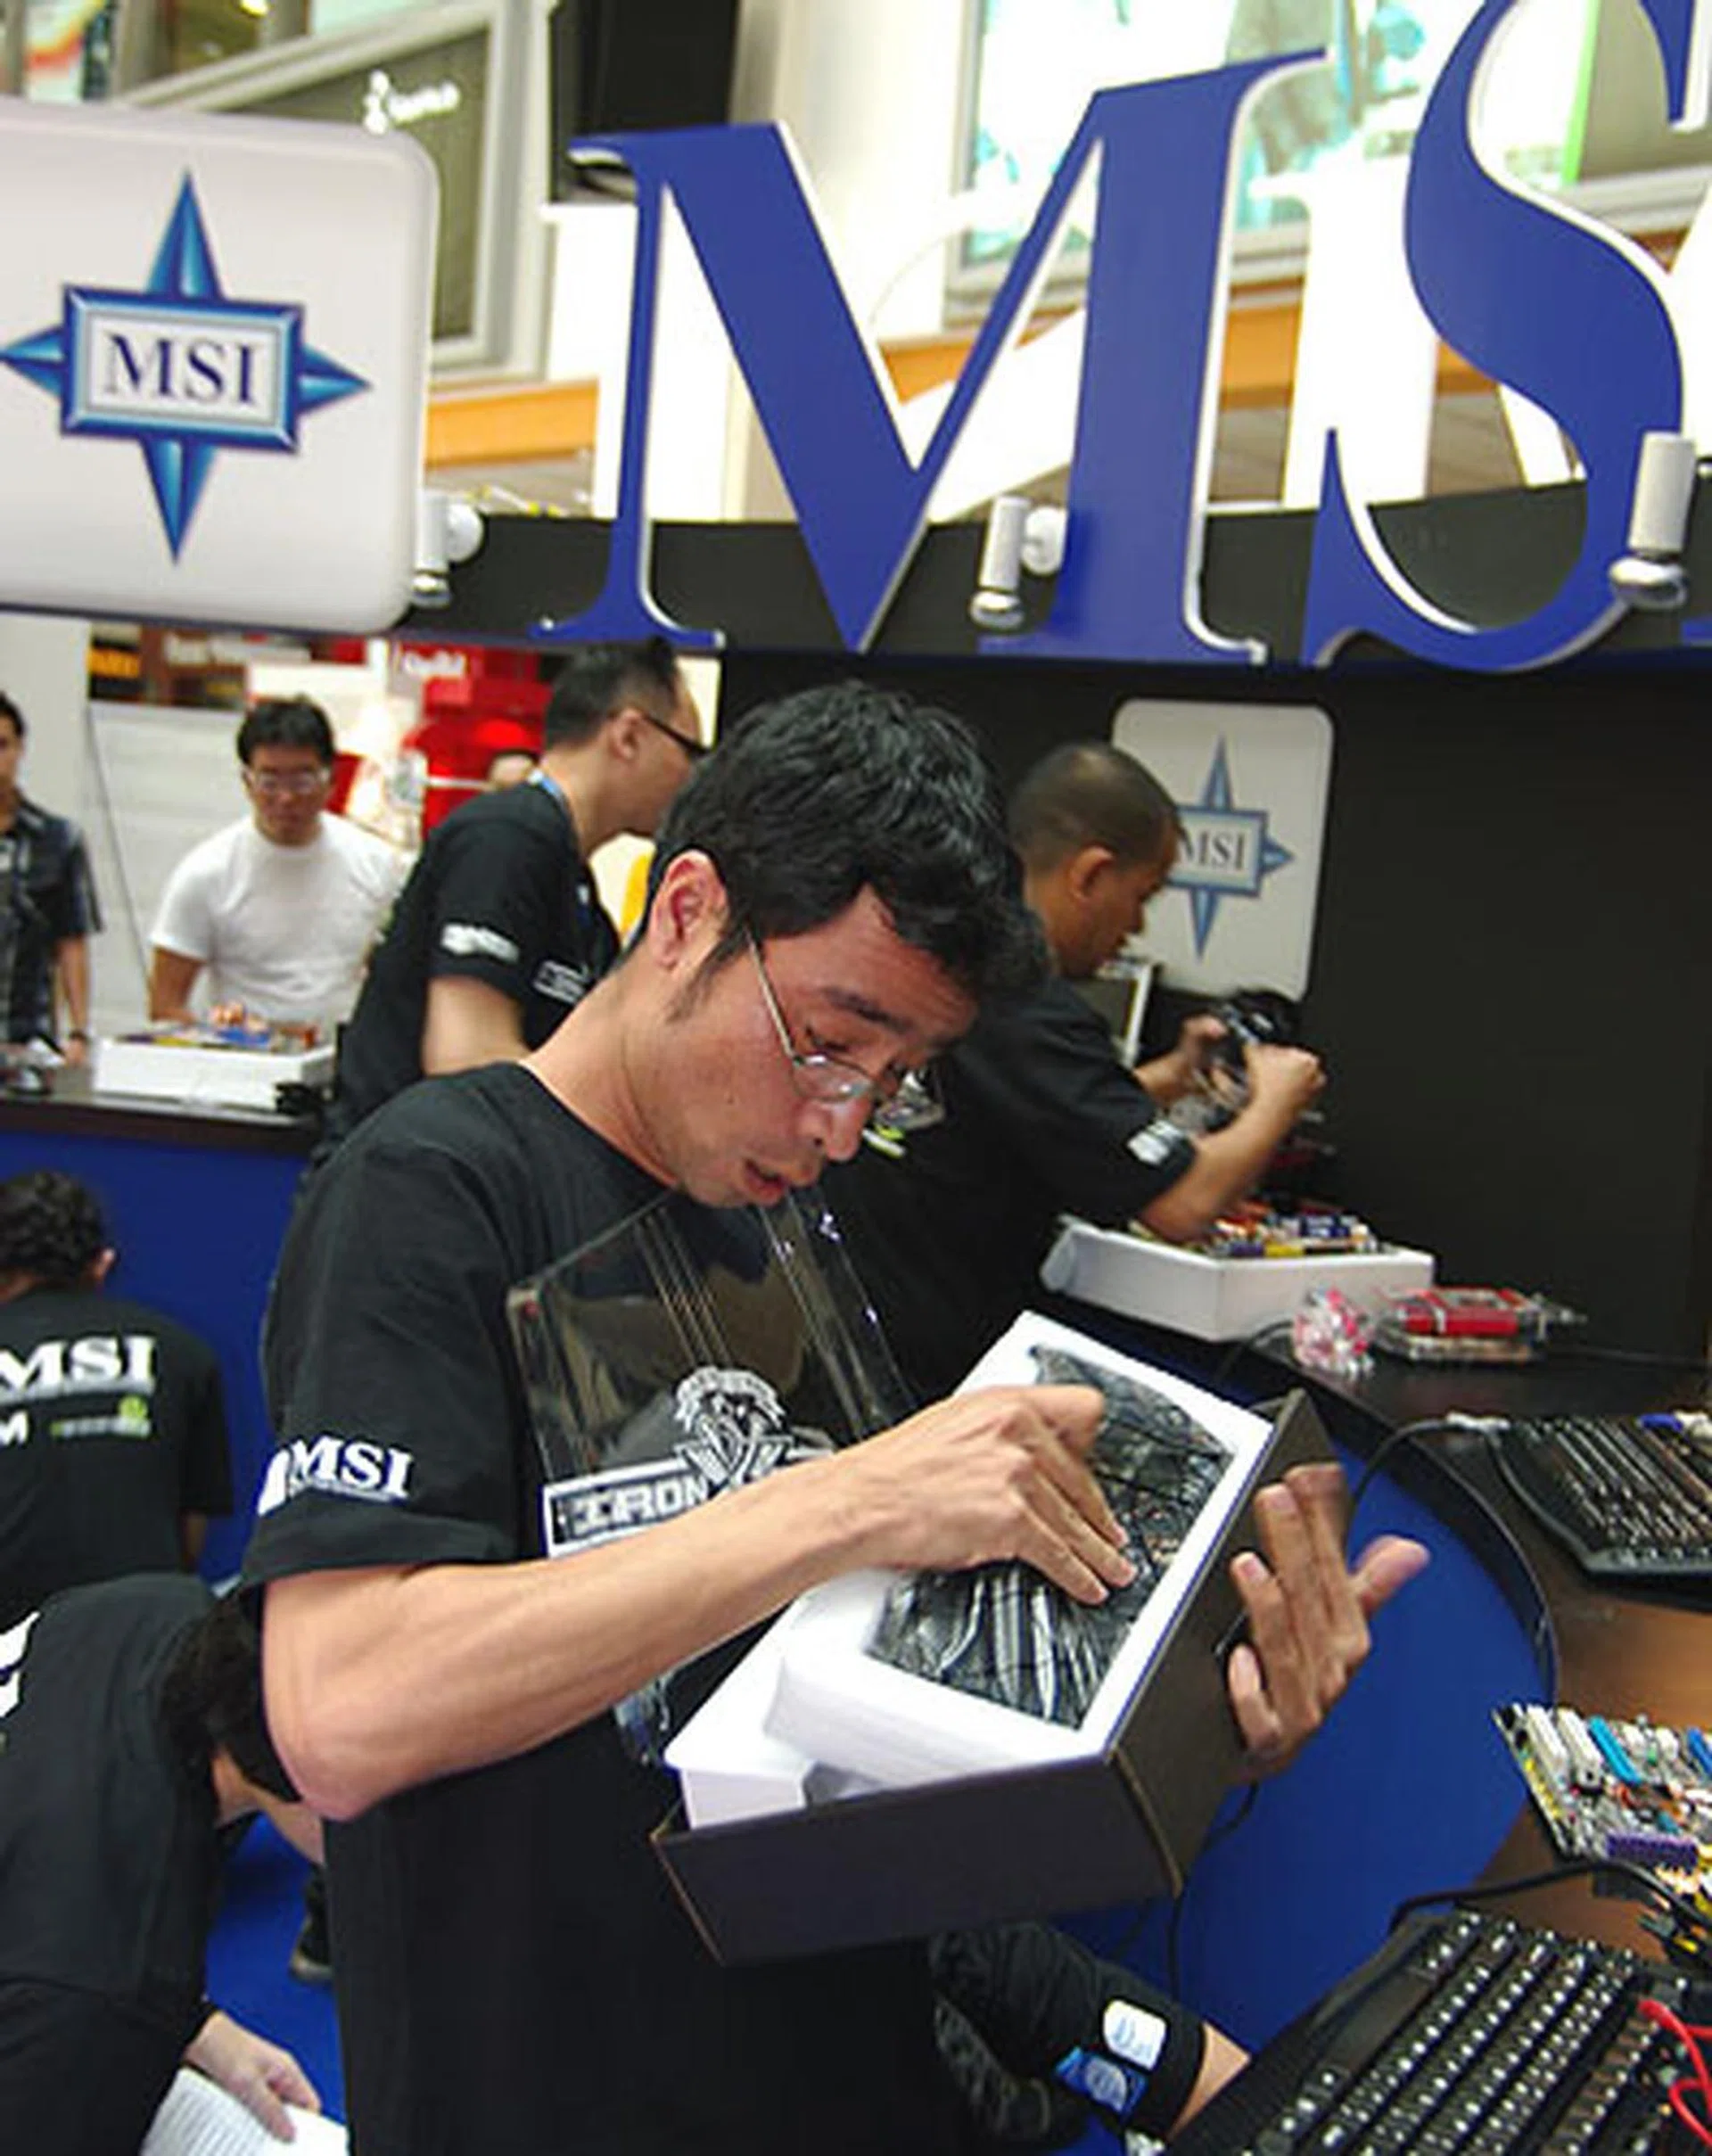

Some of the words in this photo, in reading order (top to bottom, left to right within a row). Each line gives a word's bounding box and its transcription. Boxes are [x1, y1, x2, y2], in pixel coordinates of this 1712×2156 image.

[102, 330, 259, 405] MSI
[532, 0, 1712, 673] MS
[1176, 827, 1247, 871] MSI
[0, 1336, 156, 1392] MSI
[288, 1435, 413, 1500] MSI
[569, 1477, 709, 1536] IRON
